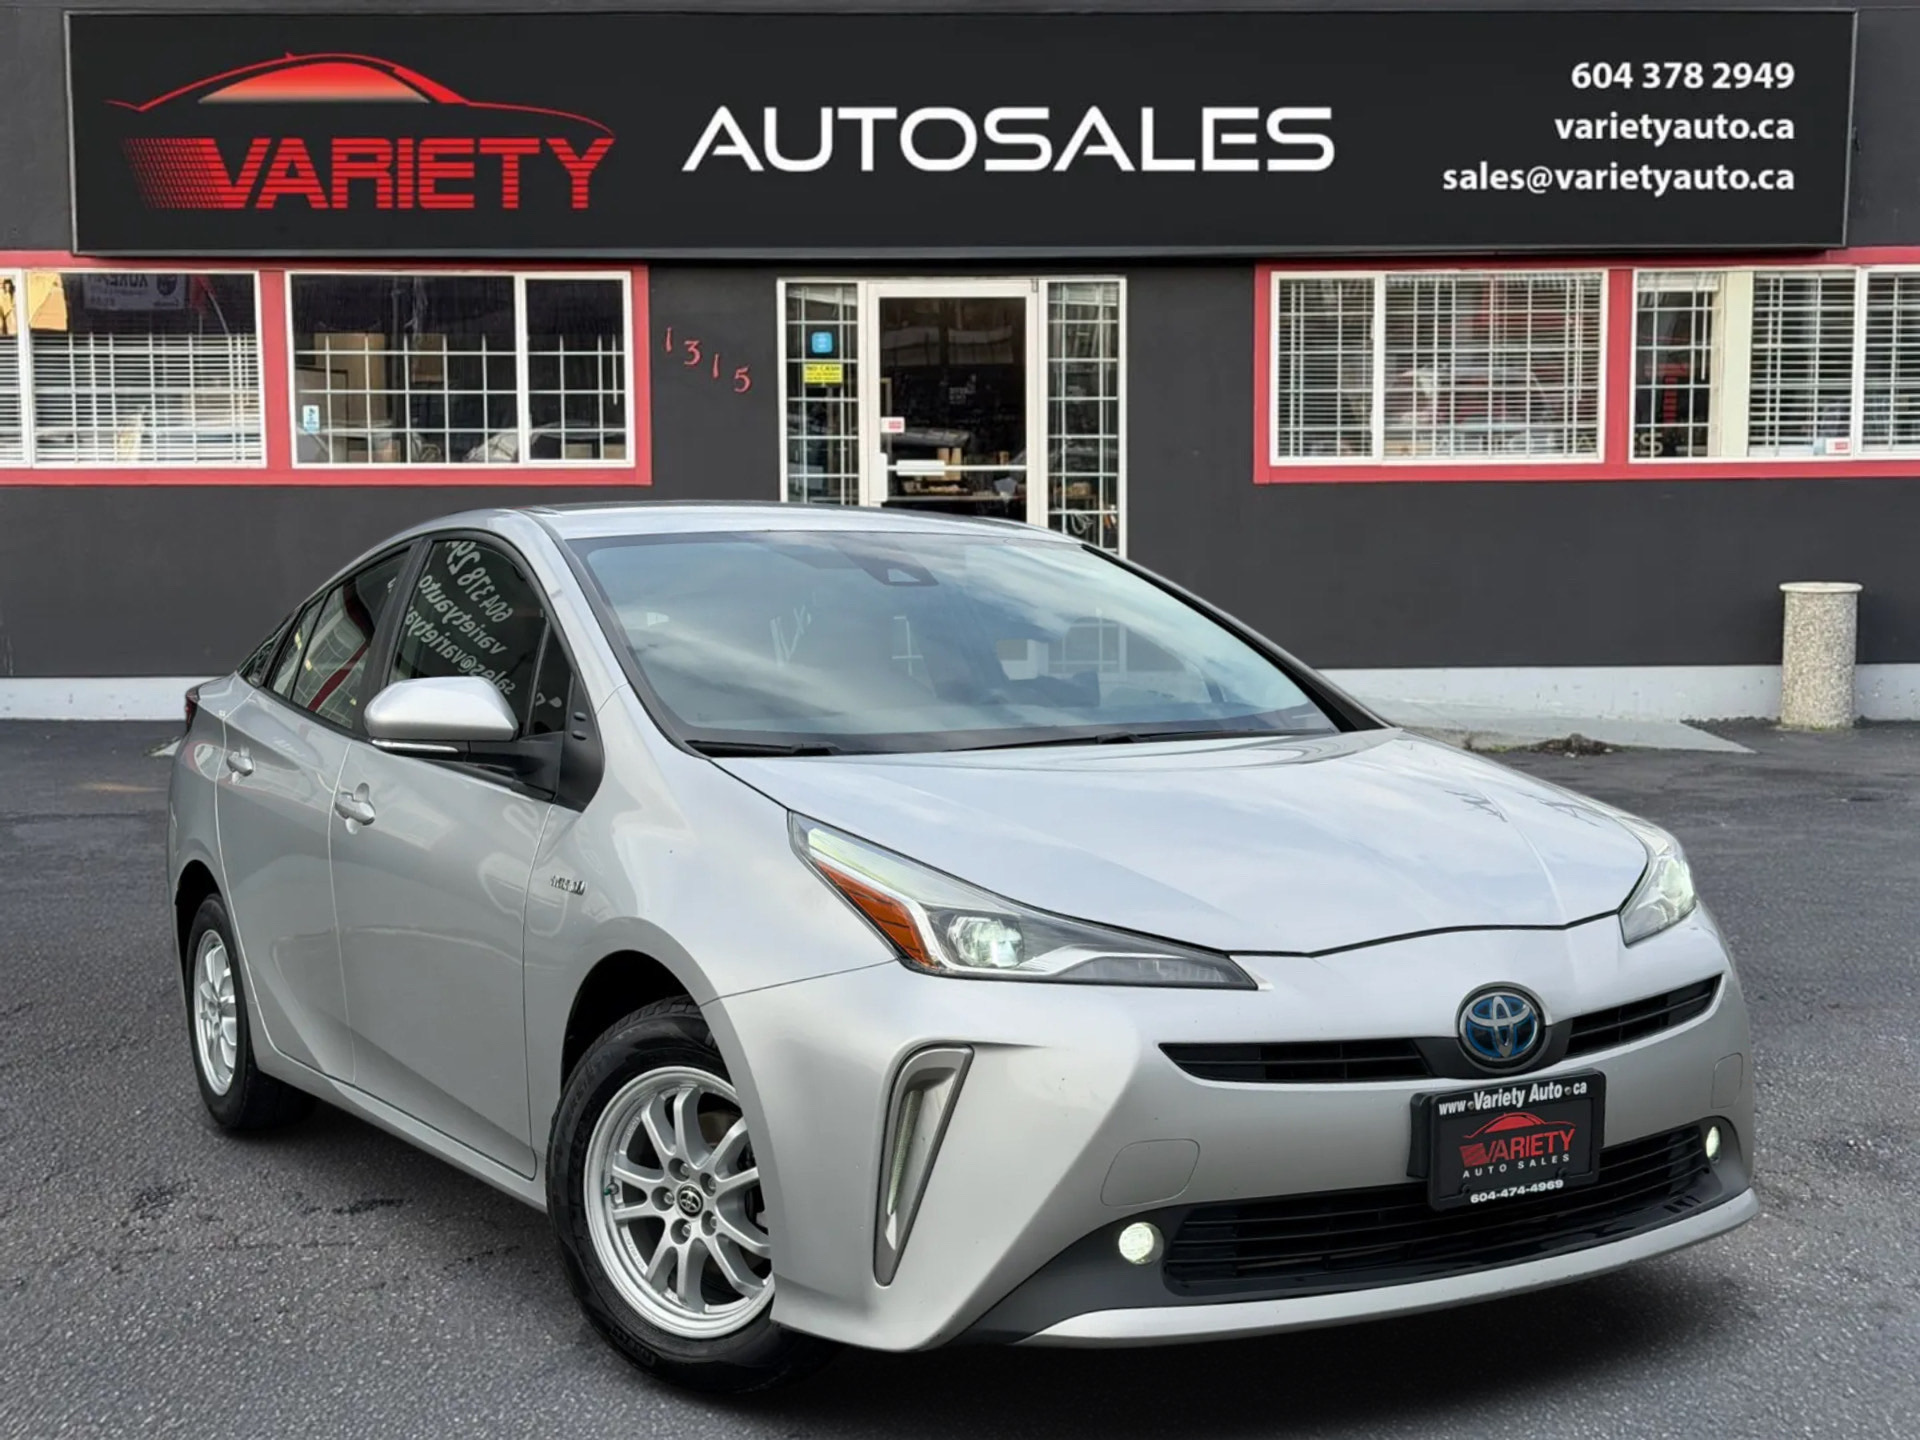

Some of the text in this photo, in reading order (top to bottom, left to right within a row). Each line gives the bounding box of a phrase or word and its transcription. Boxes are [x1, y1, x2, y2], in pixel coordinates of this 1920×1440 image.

[1571, 62, 1795, 89] 604 378 2949
[682, 106, 1335, 172] AUTOSALES
[1554, 111, 1795, 147] varietyauto.ca
[122, 136, 616, 210] VARIETY
[1443, 161, 1795, 197] sales@varietyauto.ca
[1474, 1087, 1526, 1111] Variety
[1529, 1081, 1562, 1103] Auto
[1459, 1128, 1576, 1168] VARIETY
[1463, 1153, 1570, 1179] AUTO SALES
[1470, 1179, 1564, 1204] 604-474-4969
